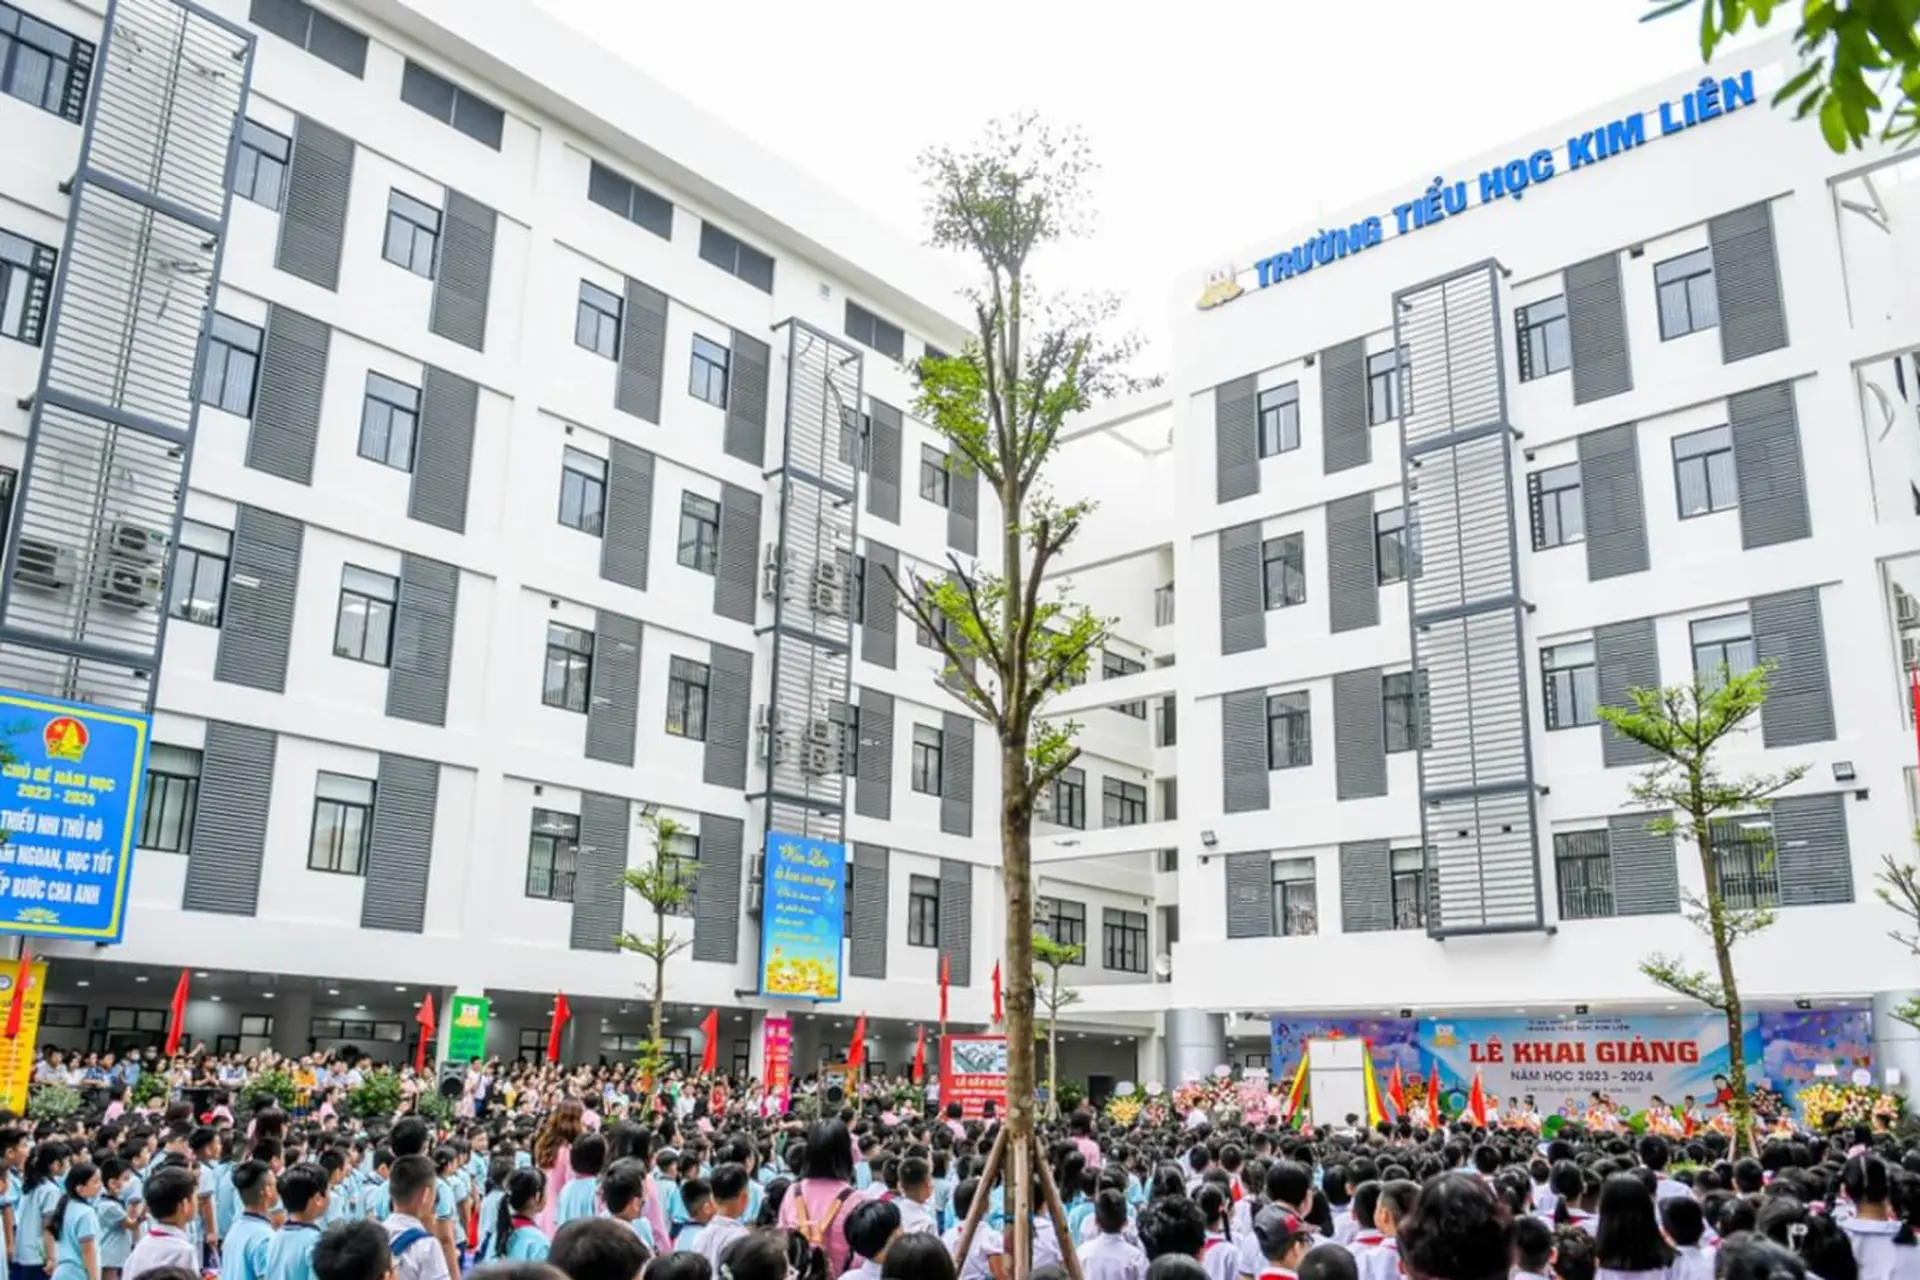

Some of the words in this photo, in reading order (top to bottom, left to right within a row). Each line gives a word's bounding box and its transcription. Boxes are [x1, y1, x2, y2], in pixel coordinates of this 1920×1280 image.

[1254, 215, 1382, 288] TRƯỜNG
[1391, 176, 1467, 235] TIỂU
[1479, 148, 1555, 204] HỌC
[1567, 111, 1645, 170] KIM
[1659, 69, 1756, 136] LIÊN
[1, 806, 36, 833] THIẾU
[16, 844, 63, 872] NGOAN,
[65, 850, 91, 875] HỌC
[92, 848, 114, 875] TỐT
[47, 880, 72, 903] CHA
[74, 883, 101, 905] ANH
[1512, 1041, 1586, 1063] KHAI
[1596, 1035, 1699, 1063] GIẢNG
[1510, 1070, 1540, 1081] NĂM
[1544, 1071, 1573, 1083] HỌC
[1578, 1071, 1609, 1081] 2023
[1621, 1071, 1654, 1081] 2024
